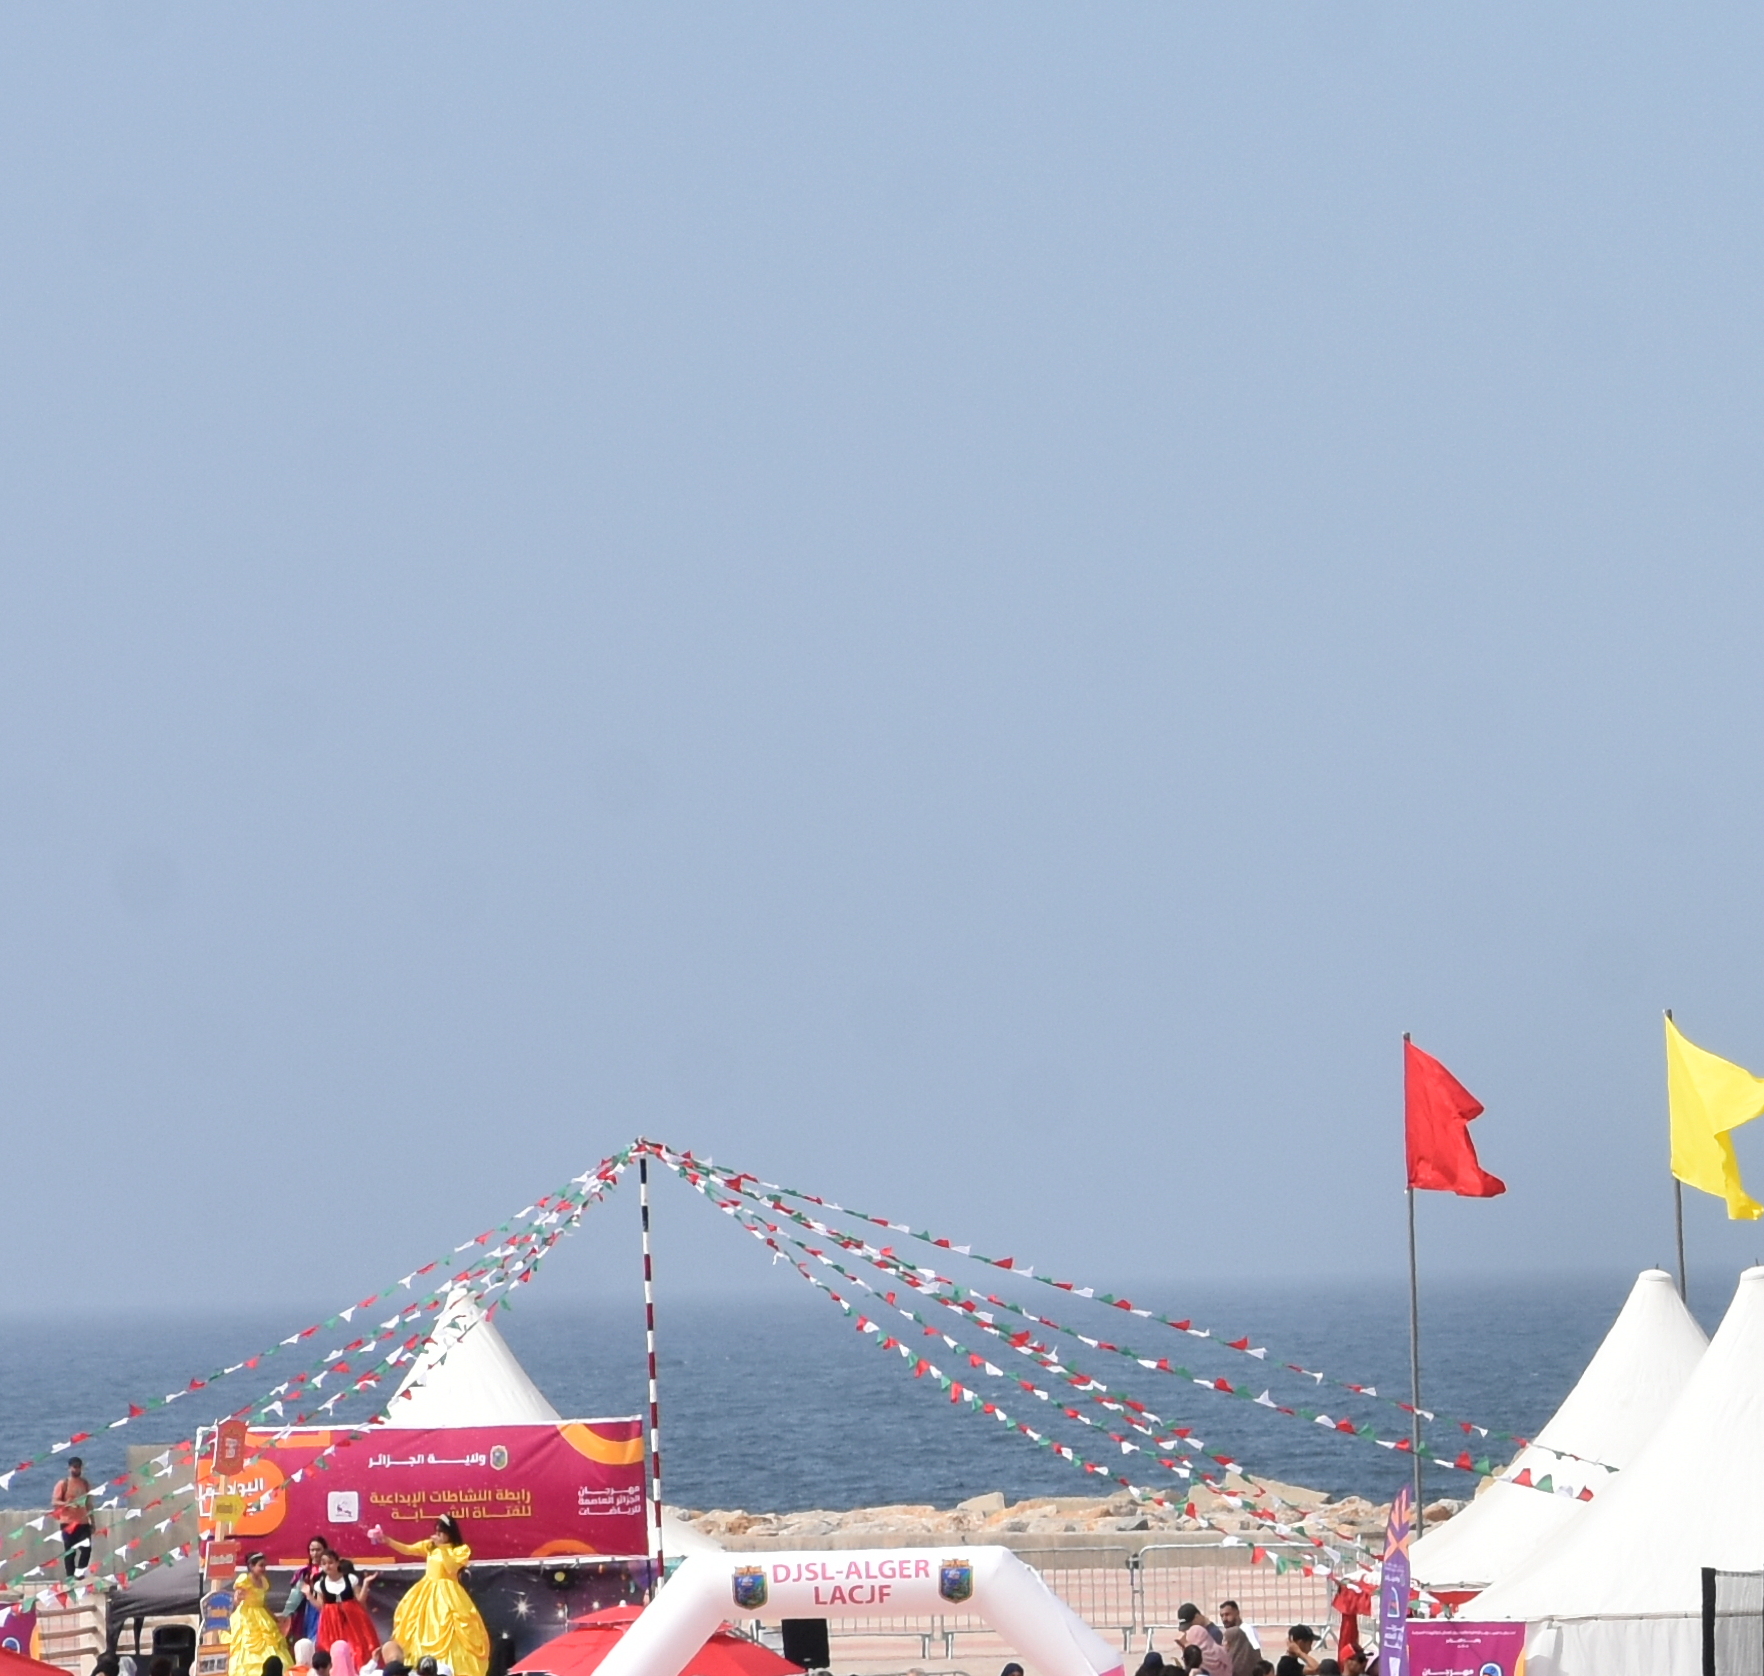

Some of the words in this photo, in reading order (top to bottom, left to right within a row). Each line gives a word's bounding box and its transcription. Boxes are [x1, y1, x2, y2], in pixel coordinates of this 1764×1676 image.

[368, 1453, 424, 1468] الجزائر
[369, 1491, 426, 1508] الإبداعية
[430, 1489, 492, 1504] النشاطات
[495, 1489, 531, 1504] رابطة
[772, 1559, 930, 1583] DJSL-ALGER
[813, 1585, 892, 1605] LACJF
